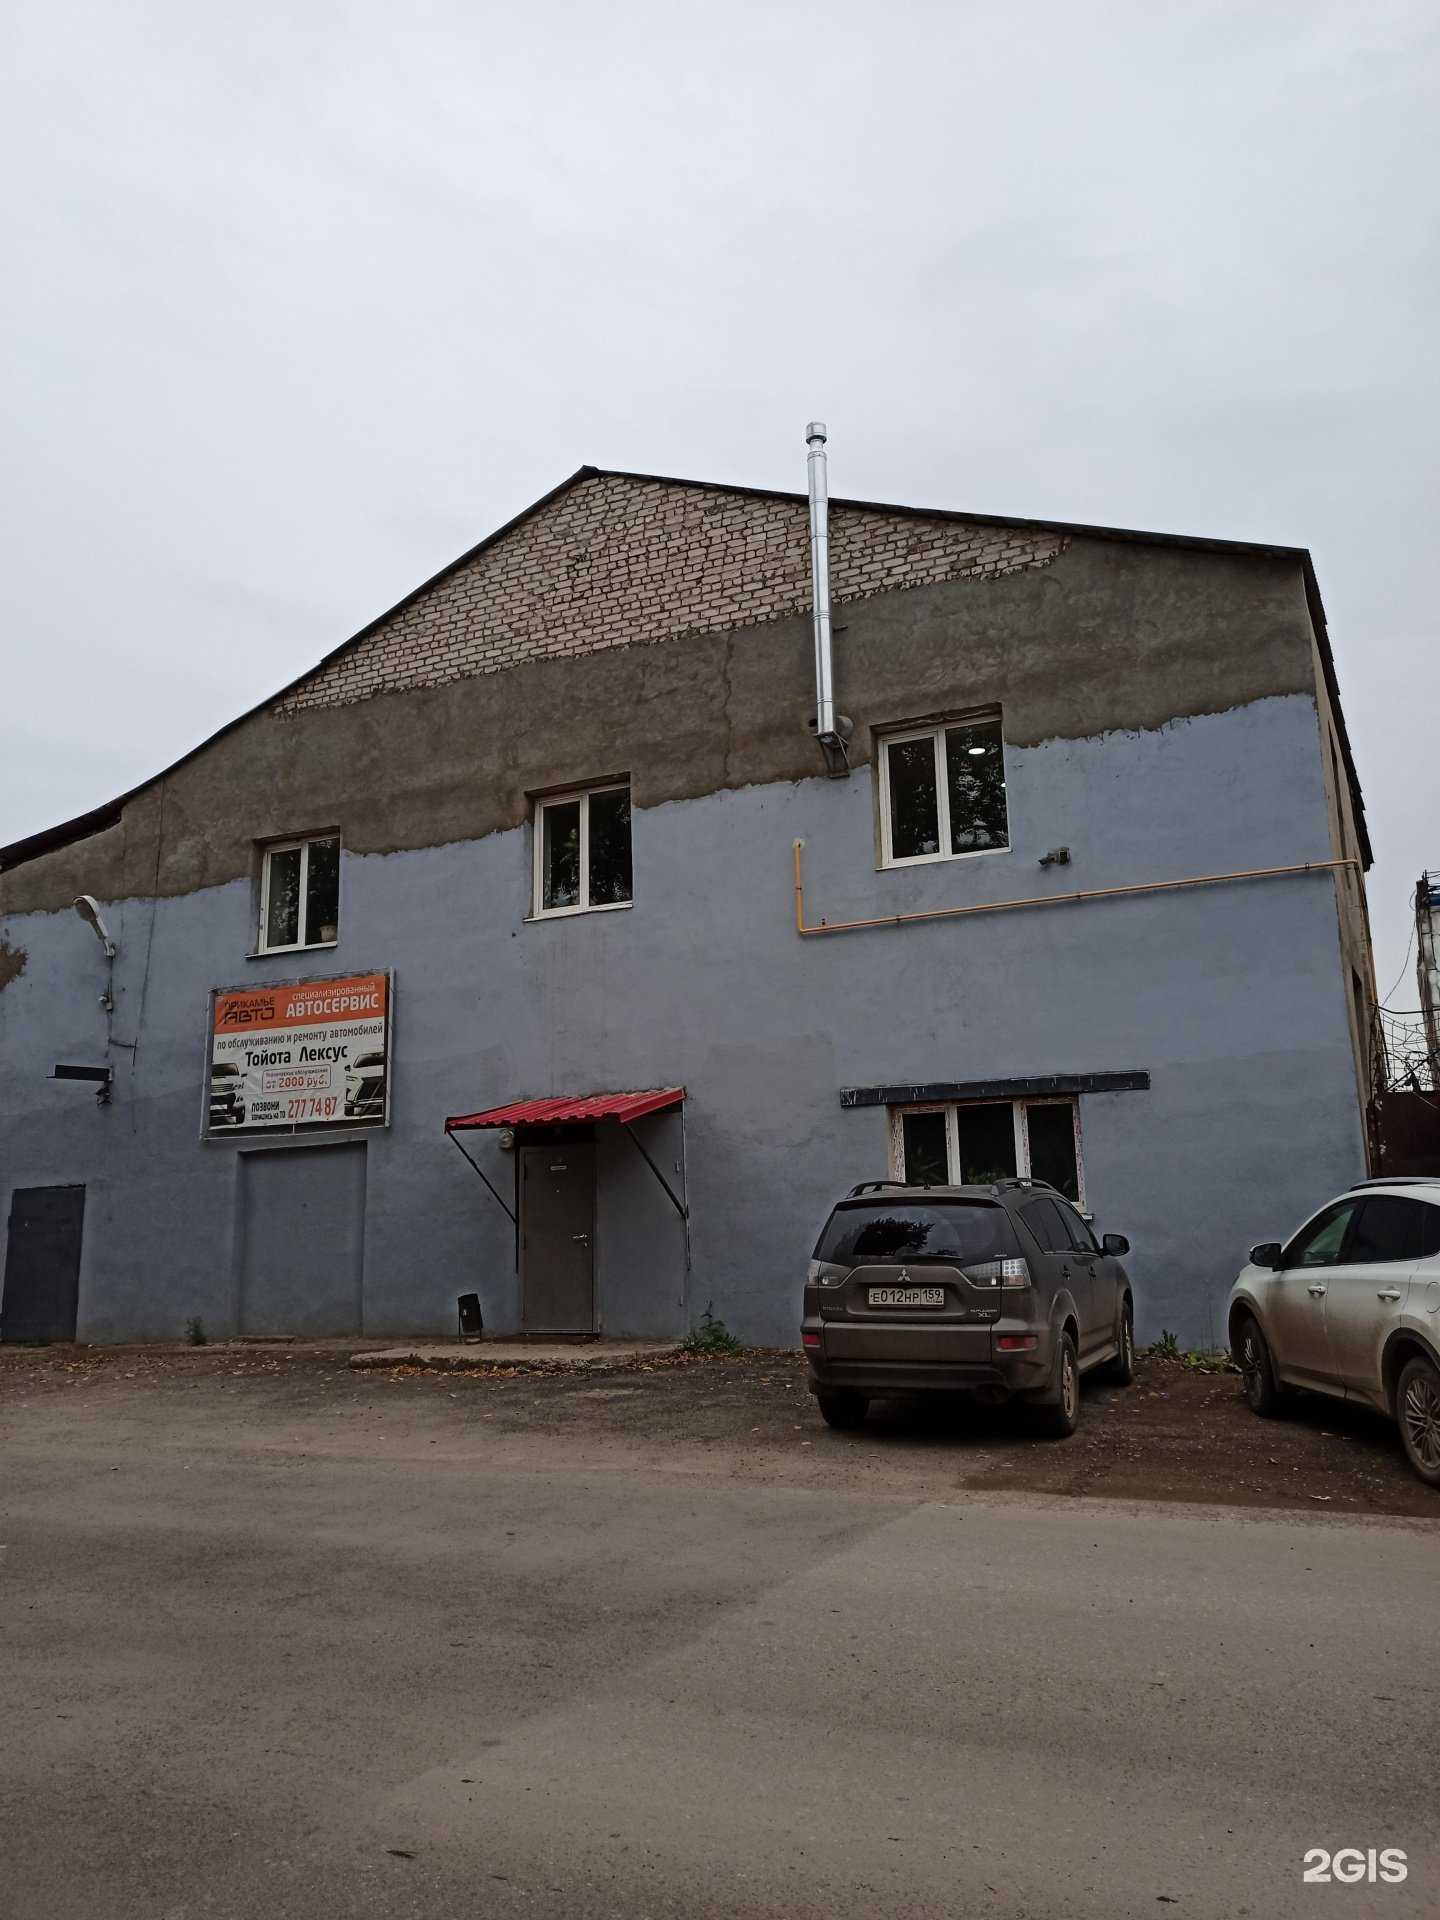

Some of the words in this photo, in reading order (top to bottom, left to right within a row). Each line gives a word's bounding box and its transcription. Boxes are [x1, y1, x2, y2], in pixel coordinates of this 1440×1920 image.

[293, 983, 375, 1001] специализированный
[286, 993, 379, 1018] АВТОСЕРВИС
[217, 1041, 226, 1050] по
[228, 1035, 285, 1050] обслуживанию
[286, 1033, 292, 1041] и
[293, 1030, 327, 1044] ремонту
[329, 1022, 383, 1038] автомобилей
[245, 1049, 291, 1067] Тойота
[299, 1045, 348, 1062] Лексус
[266, 1080, 277, 1088] от
[279, 1076, 304, 1088] 2000
[288, 1099, 306, 1118] 277
[310, 1098, 321, 1116] 74
[324, 1097, 337, 1115] 87
[922, 1289, 941, 1300] 159
